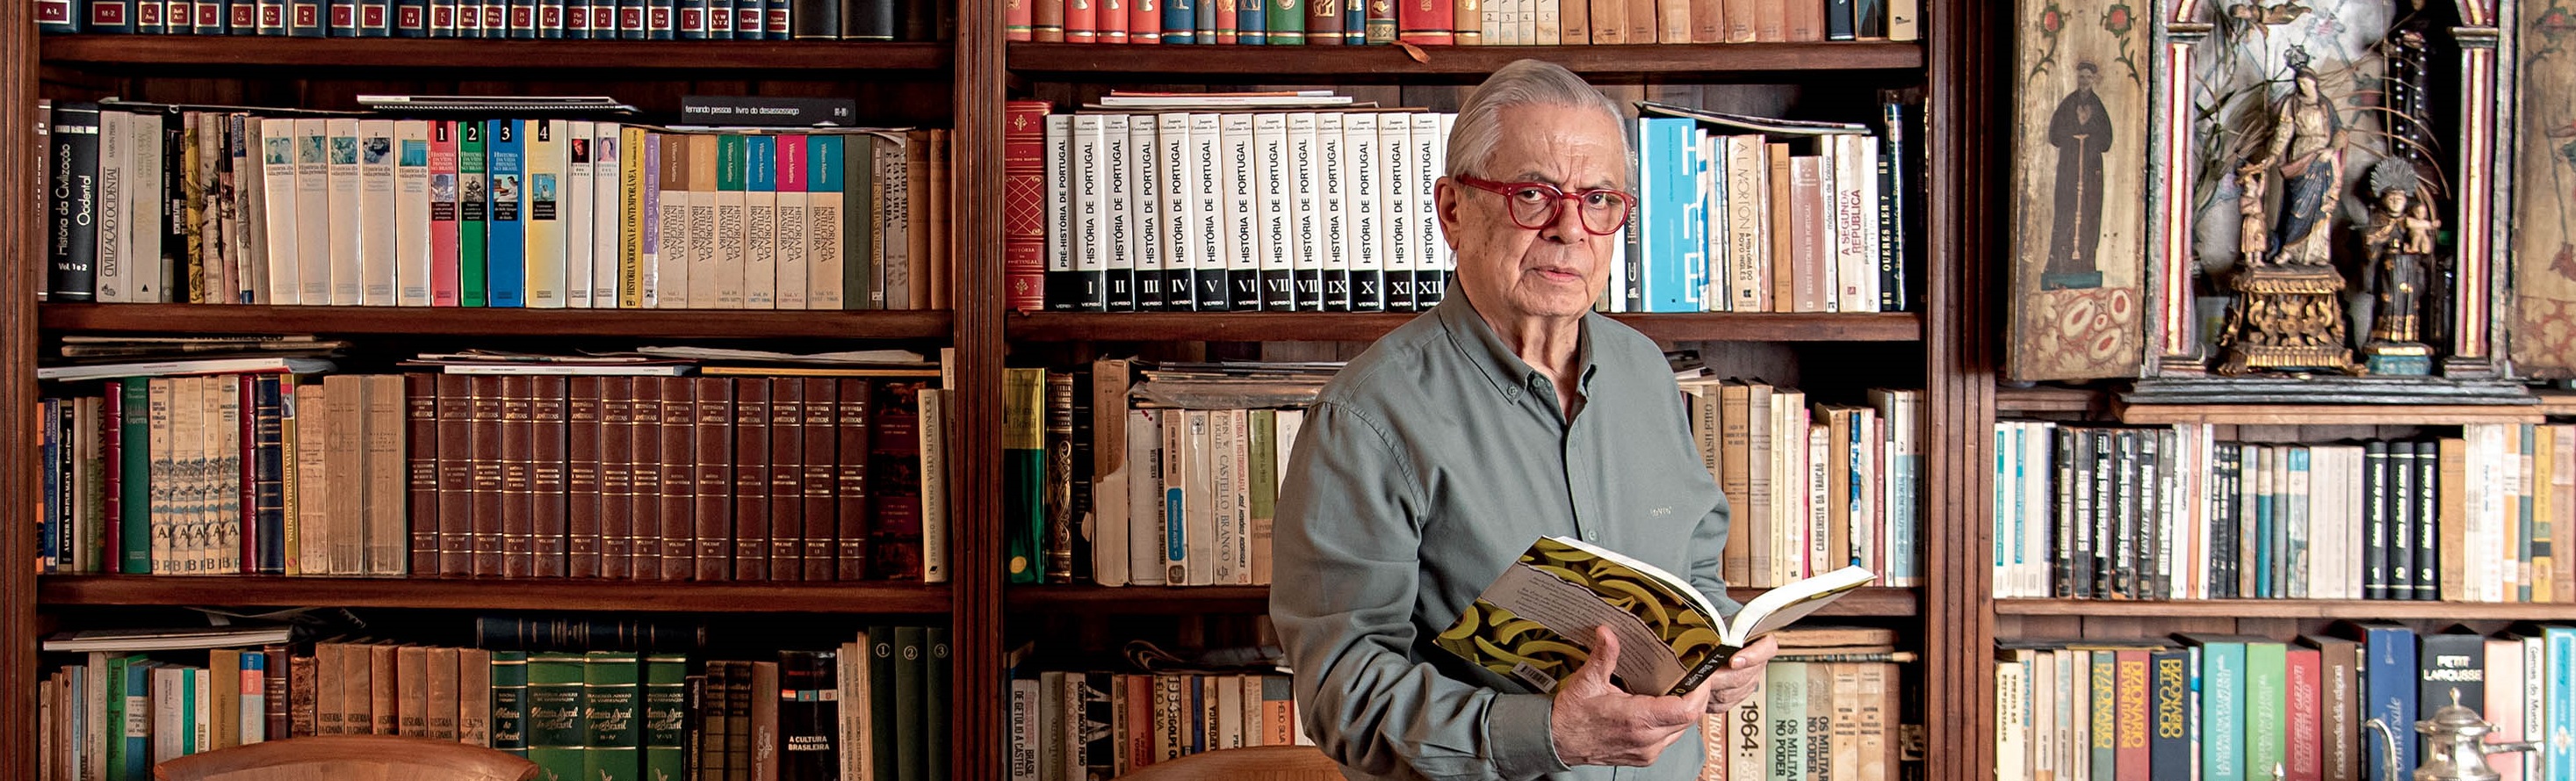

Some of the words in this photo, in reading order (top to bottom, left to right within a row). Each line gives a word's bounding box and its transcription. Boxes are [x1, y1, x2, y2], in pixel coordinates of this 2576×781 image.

[439, 127, 444, 141] 1
[468, 127, 477, 141] 2
[501, 127, 510, 141] 3
[539, 127, 548, 140] 4
[1737, 142, 1749, 153] A
[55, 143, 70, 199] Civilização
[1085, 141, 1093, 196] PORTUGAL
[1113, 139, 1122, 193] PORTUGAL
[1143, 141, 1151, 195] PORTUGAL
[1171, 140, 1180, 194] PORTUGAL
[1237, 141, 1246, 195] PORTUGAL
[1269, 140, 1279, 195] PORTUGAL
[1299, 139, 1309, 194] PORTUGAL
[1327, 139, 1338, 194] PORTUGAL
[1360, 141, 1368, 195] PORTUGAL
[1392, 140, 1401, 195] PORTUGAL
[1421, 140, 1431, 195] PORTUGAL
[1737, 156, 1744, 166] L
[76, 176, 91, 226] Ocidental
[105, 169, 116, 218] OCIDENTAL
[626, 169, 637, 227] CONTEMPORÂNEA
[1060, 191, 1066, 202] DE
[1737, 169, 1750, 228] MORTON
[1827, 184, 1831, 193] de
[56, 200, 69, 211] da
[1086, 200, 1094, 214] DE
[1115, 197, 1122, 211] DE
[1144, 199, 1152, 213] DE
[1173, 198, 1181, 212] DE
[1205, 198, 1213, 212] DE
[1239, 199, 1248, 213] DE
[1272, 199, 1280, 212] DE
[1302, 198, 1310, 211] DE
[1330, 198, 1338, 211] DE
[1361, 199, 1369, 213] DE
[1394, 199, 1402, 213] DE
[1424, 199, 1432, 213] DE
[1841, 190, 1851, 244] SEGUNDA
[1881, 205, 1890, 225] LER
[56, 213, 69, 256] História
[1085, 217, 1094, 264] HISTÓRIA
[1114, 214, 1124, 261] HISTÓRIA
[1144, 217, 1154, 264] HISTÓRIA
[1173, 215, 1184, 263] HISTÓRIA
[1204, 216, 1216, 263] HISTÓRIA
[1239, 217, 1250, 264] HISTÓRIA
[1272, 216, 1282, 264] HISTÓRIA
[1301, 215, 1312, 262] HISTÓRIA
[1329, 215, 1340, 263] HISTÓRIA
[1360, 217, 1371, 264] HISTÓRIA
[1393, 217, 1403, 264] HISTÓRIA
[1422, 217, 1433, 264] HISTÓRIA
[105, 220, 116, 277] CIVILIZAÇÃO
[627, 234, 636, 264] MODERNA
[677, 246, 684, 258] DA
[1842, 244, 1851, 256] A
[625, 264, 636, 296] HISTÓRIA
[1088, 281, 1093, 295] I
[1115, 280, 1125, 293] II
[1144, 279, 1159, 293] III
[1172, 279, 1188, 293] IV
[1206, 279, 1218, 293] V
[1238, 279, 1255, 293] VI
[1267, 279, 1288, 293] VII
[1328, 279, 1346, 293] IX
[1361, 281, 1375, 294] X
[1391, 281, 1411, 294] XI
[1418, 280, 1442, 294] XII
[1704, 404, 1714, 469] BRASILEIRO
[1219, 455, 1230, 510] CASTELLO
[1815, 462, 1825, 490] TRAIÇÃO
[1816, 493, 1824, 504] DA
[1221, 515, 1230, 562] BRANCO
[1815, 504, 1824, 552] CARREIRISTA
[2372, 567, 2380, 580] 1
[2395, 566, 2406, 580] 2
[2422, 568, 2433, 581] 3
[2160, 659, 2170, 685] DEL
[2436, 655, 2470, 668] PETIT
[2530, 646, 2539, 679] Gemas
[2423, 669, 2483, 681] LAROUSSE
[1014, 691, 1024, 701] DE
[2170, 659, 2183, 738] DIZIONARIO
[2530, 684, 2537, 696] do
[2131, 661, 2145, 748] DIZIONARIO
[2160, 686, 2171, 738] CALCIO
[2530, 698, 2539, 734] Mundo
[1168, 719, 1177, 748] GOLPE
[1741, 701, 1758, 756] 1964:
[1776, 720, 1786, 736] NO
[1787, 720, 1798, 734] OS
[1808, 717, 1816, 733] NO
[1819, 717, 1829, 734] OS
[1776, 740, 1786, 777] PODER
[1808, 737, 1816, 773] PODER
